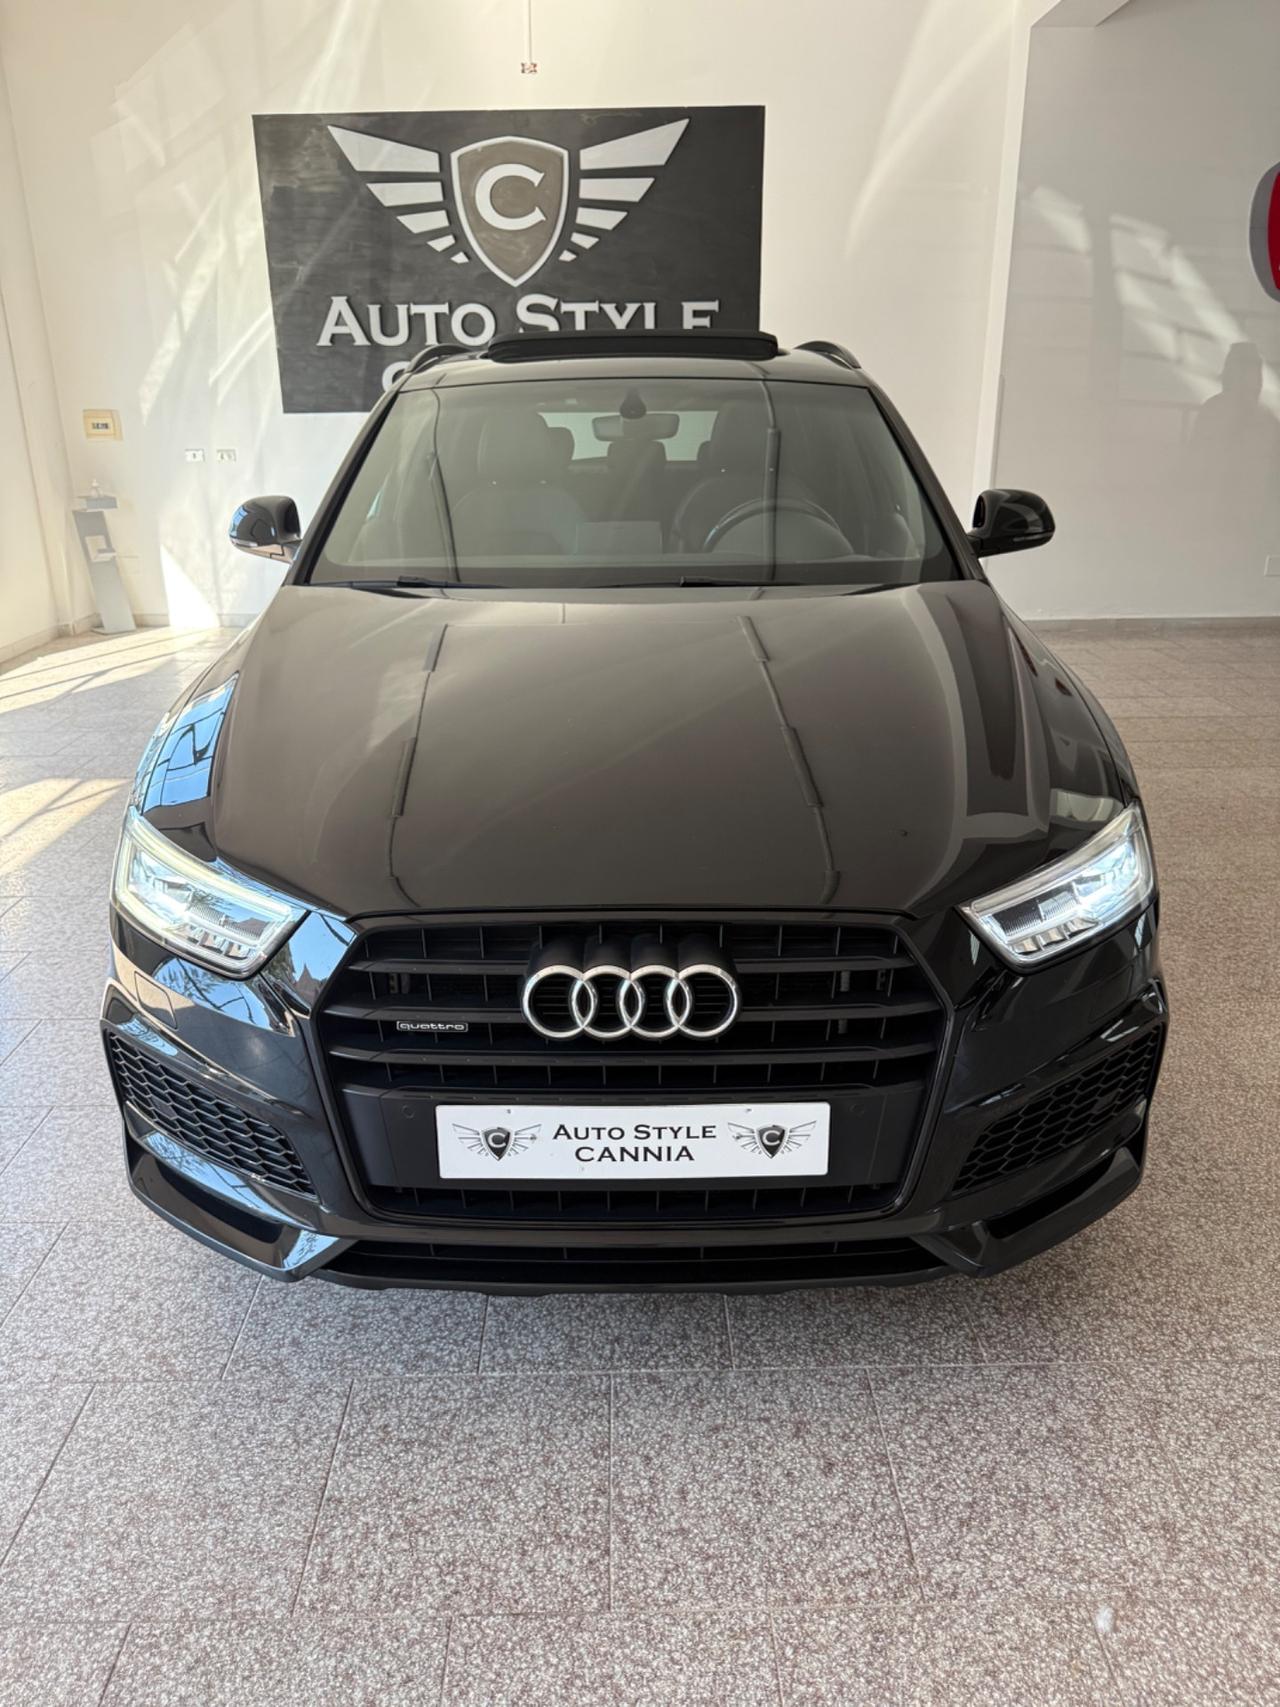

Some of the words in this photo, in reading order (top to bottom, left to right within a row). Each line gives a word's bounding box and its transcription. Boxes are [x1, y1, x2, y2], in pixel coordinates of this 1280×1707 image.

[474, 163, 546, 231] C
[316, 296, 497, 347] AUTO
[399, 1022, 466, 1031] quattro
[487, 1132, 507, 1148] C
[552, 1124, 625, 1140] AUTO
[633, 1124, 717, 1140] STYLE
[762, 1130, 781, 1146] C
[575, 1145, 695, 1162] CANNIA
